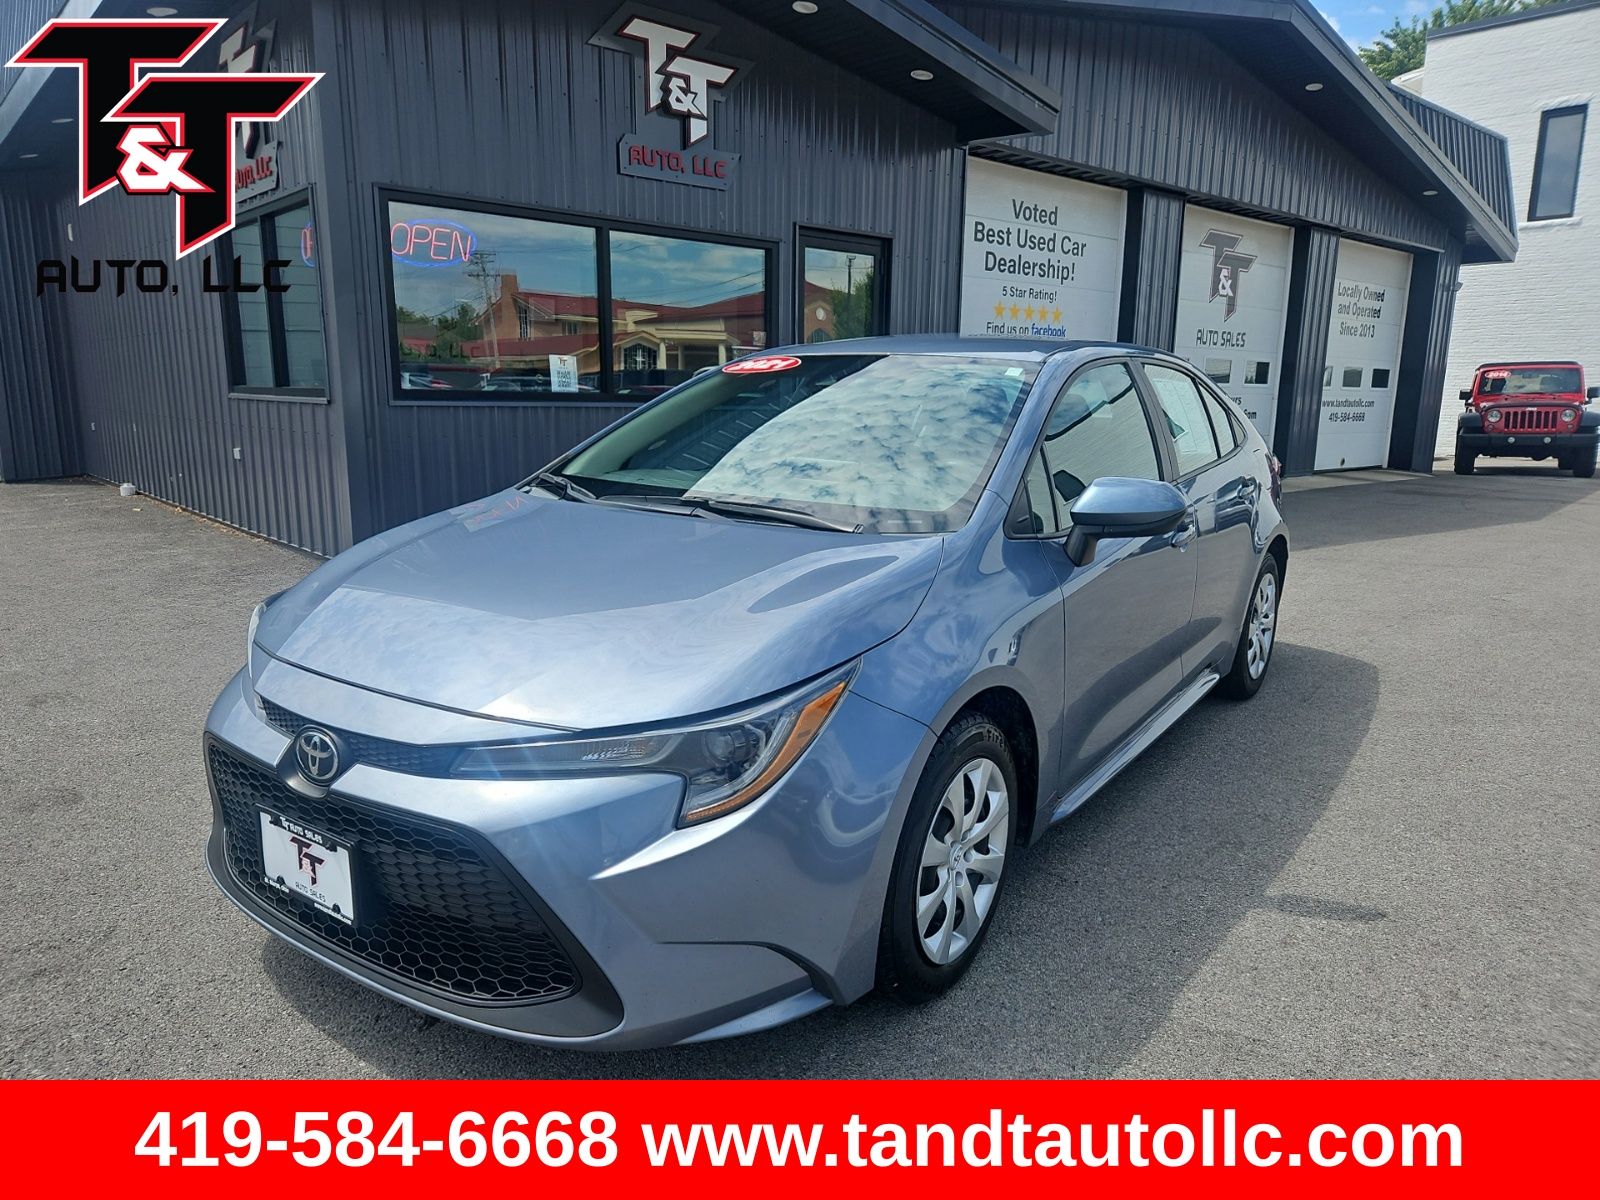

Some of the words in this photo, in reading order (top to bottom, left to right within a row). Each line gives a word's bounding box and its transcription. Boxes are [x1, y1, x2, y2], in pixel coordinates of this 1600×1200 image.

[617, 15, 739, 148] T&T
[629, 144, 685, 174] AUTO,
[692, 154, 728, 179] LLC
[1012, 199, 1058, 226] Voted
[390, 221, 472, 263] OPEN
[974, 221, 1012, 247] Best
[1017, 228, 1056, 253] Used
[1061, 236, 1087, 257] Car
[985, 251, 1075, 285] Dealership!
[1199, 228, 1258, 323] T&T
[1002, 285, 1008, 297] 5
[1010, 287, 1027, 298] Star
[1029, 288, 1058, 303] Rating!
[1337, 282, 1362, 302] Locally
[1363, 286, 1386, 303] Owned
[1337, 302, 1351, 315] and
[1352, 304, 1382, 320] Operated
[986, 321, 1006, 334] Find
[1007, 325, 1018, 334] us
[1018, 326, 1029, 335] on
[1031, 323, 1067, 337] facebook
[1196, 328, 1219, 347] AUTO
[1221, 331, 1246, 348] SALES
[1339, 321, 1358, 337] Since
[1359, 324, 1375, 338] 2013
[295, 881, 309, 895] AUTO
[309, 888, 326, 902] SALES
